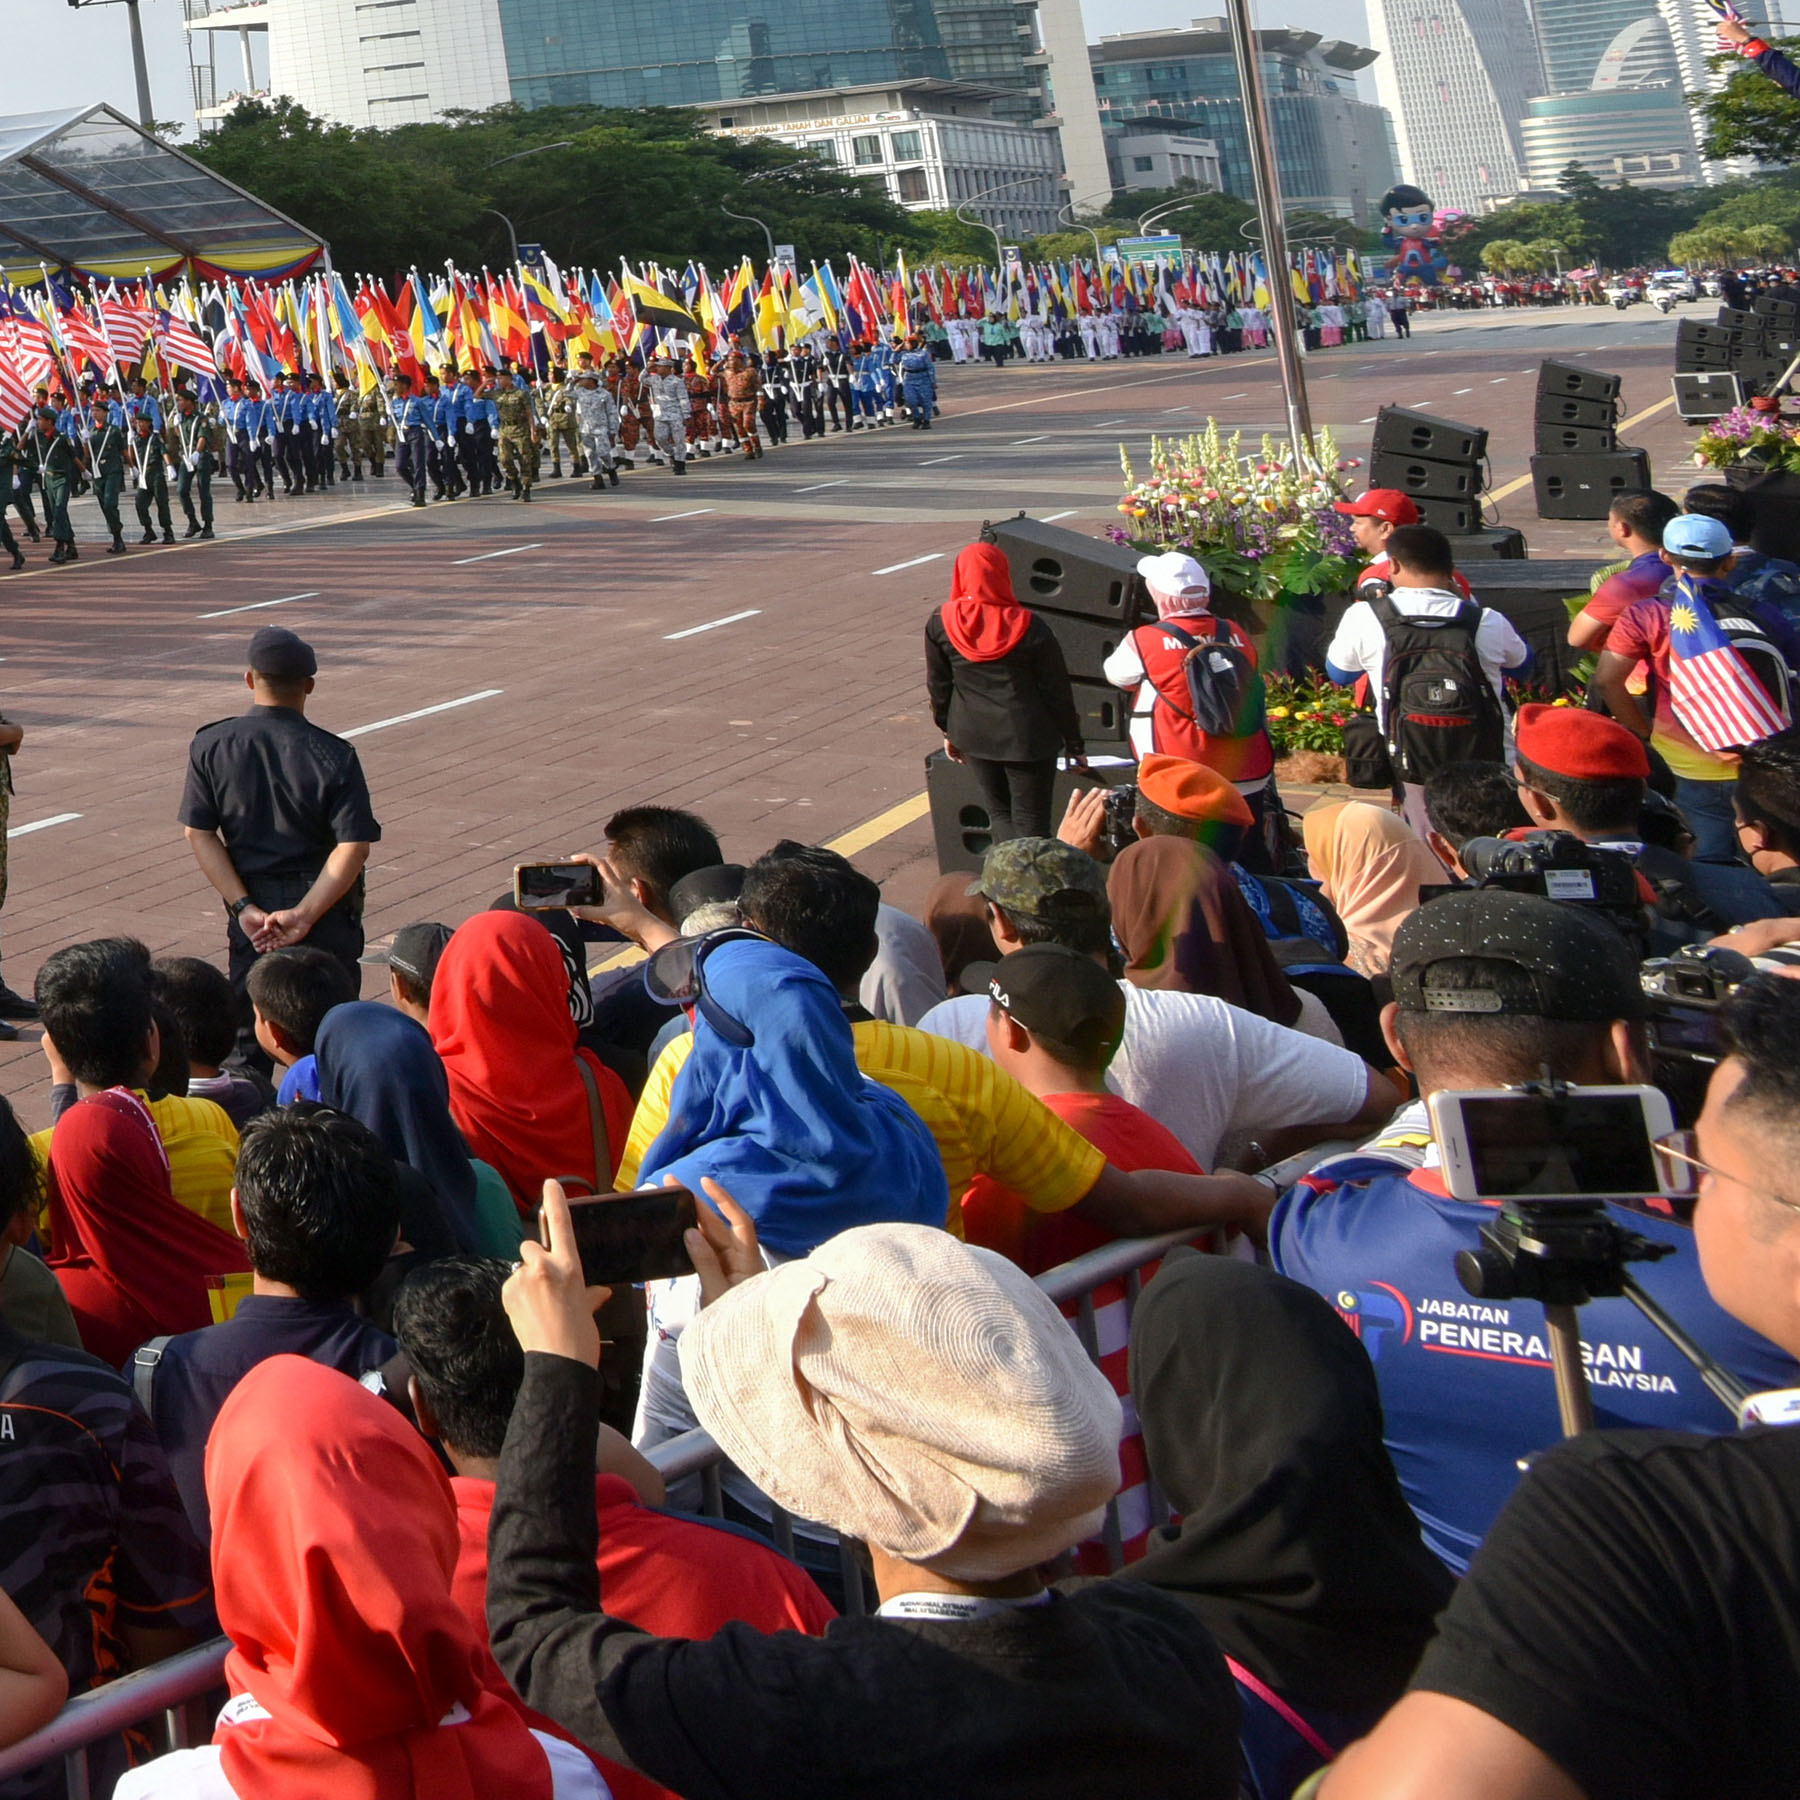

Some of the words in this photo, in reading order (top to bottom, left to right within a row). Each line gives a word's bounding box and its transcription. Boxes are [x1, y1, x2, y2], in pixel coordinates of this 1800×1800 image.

[781, 120, 812, 132] TANAH
[814, 118, 833, 129] DAN
[988, 977, 1010, 1008] FILA
[1416, 1298, 1510, 1326] JABATAN
[1419, 1319, 1642, 1371] PENERAGAN
[1582, 1366, 1679, 1395] ALAYSIA
